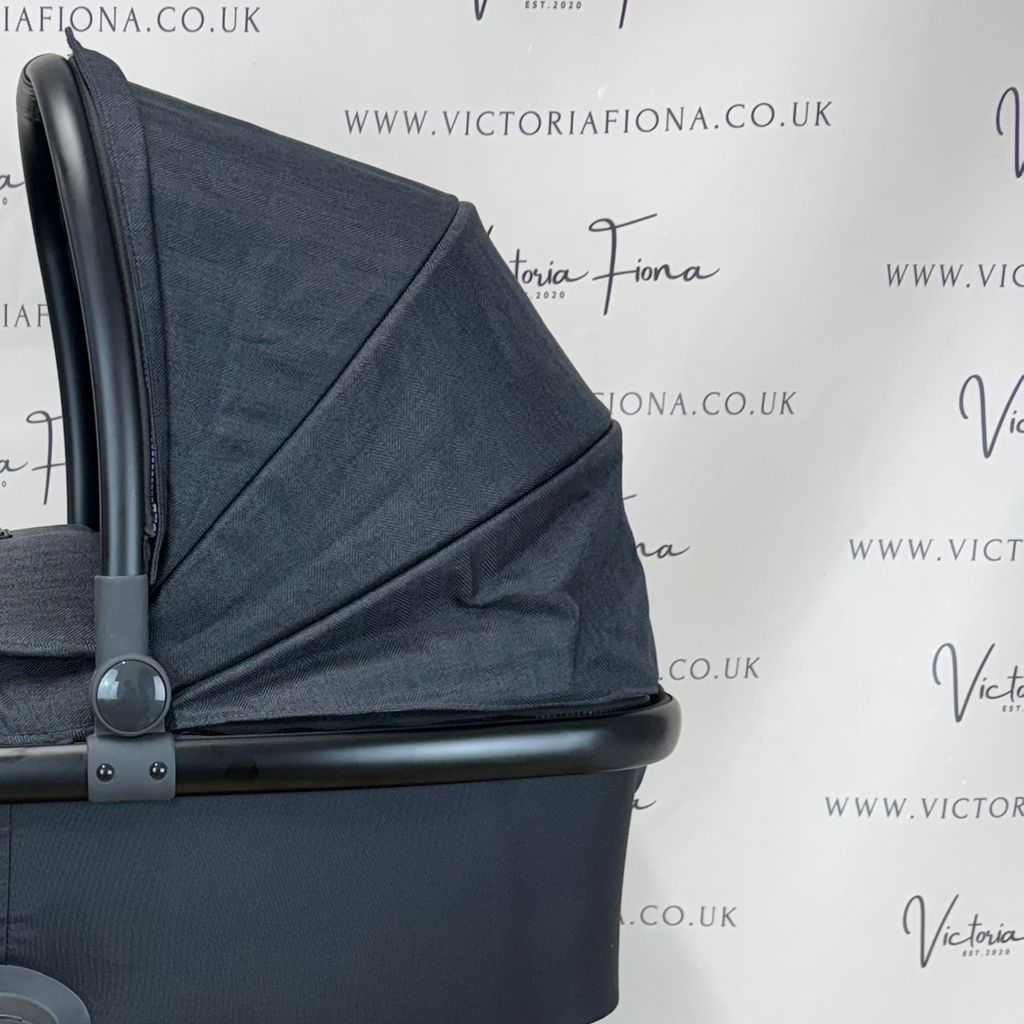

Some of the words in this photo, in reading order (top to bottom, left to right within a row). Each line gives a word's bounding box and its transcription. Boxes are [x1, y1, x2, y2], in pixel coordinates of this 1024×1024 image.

[344, 101, 833, 136] WWW.VICTORIAFIONA.CO.UK
[588, 213, 720, 316] Fiona
[594, 391, 796, 416] IONA.CO.UK
[903, 894, 1024, 968] Victoria
[961, 947, 1011, 958] EST.2020
